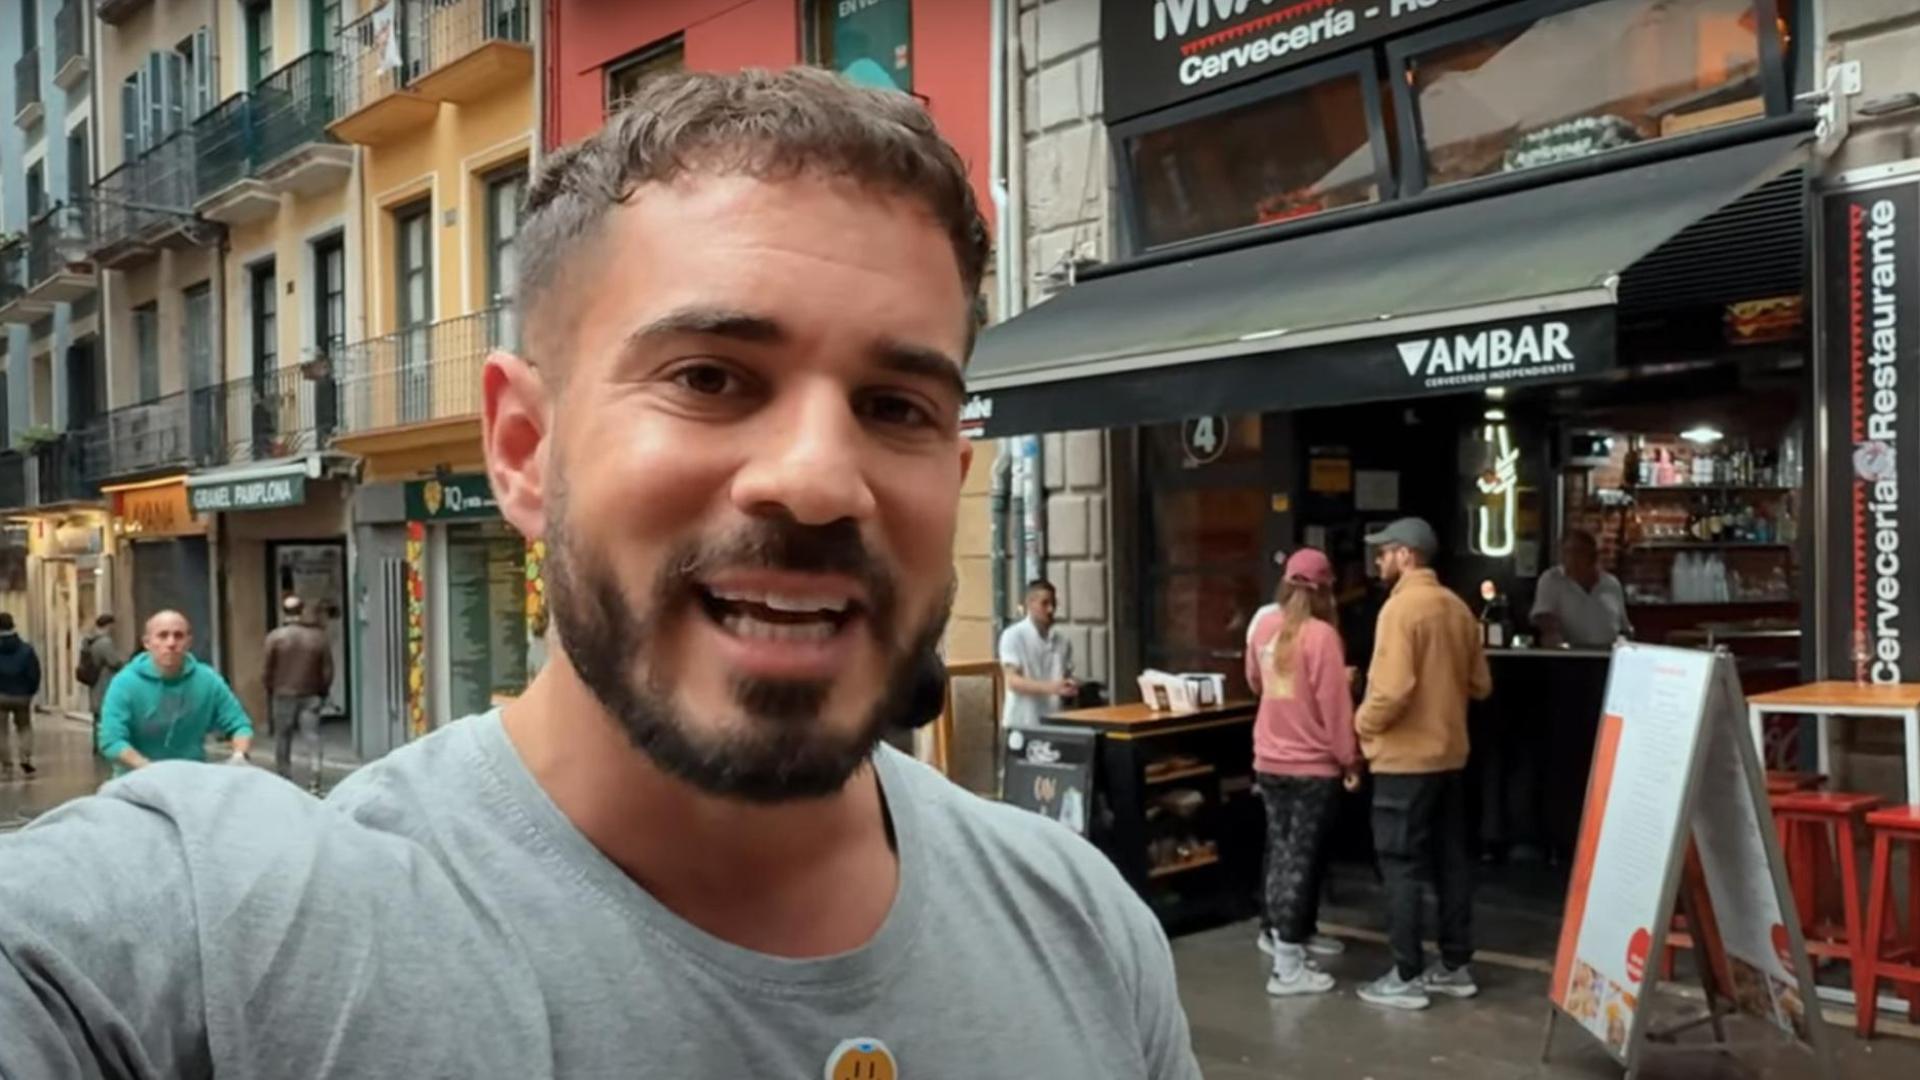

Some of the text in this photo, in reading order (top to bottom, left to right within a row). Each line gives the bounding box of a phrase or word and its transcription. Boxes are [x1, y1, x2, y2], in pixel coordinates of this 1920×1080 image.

[1179, 8, 1356, 85] Cervecería
[1425, 322, 1575, 375] AMBAR
[1868, 199, 1899, 440] Restaurante
[1193, 416, 1217, 453] 4
[234, 479, 292, 505] PAMPLONA
[1871, 480, 1900, 686] Cervecería
